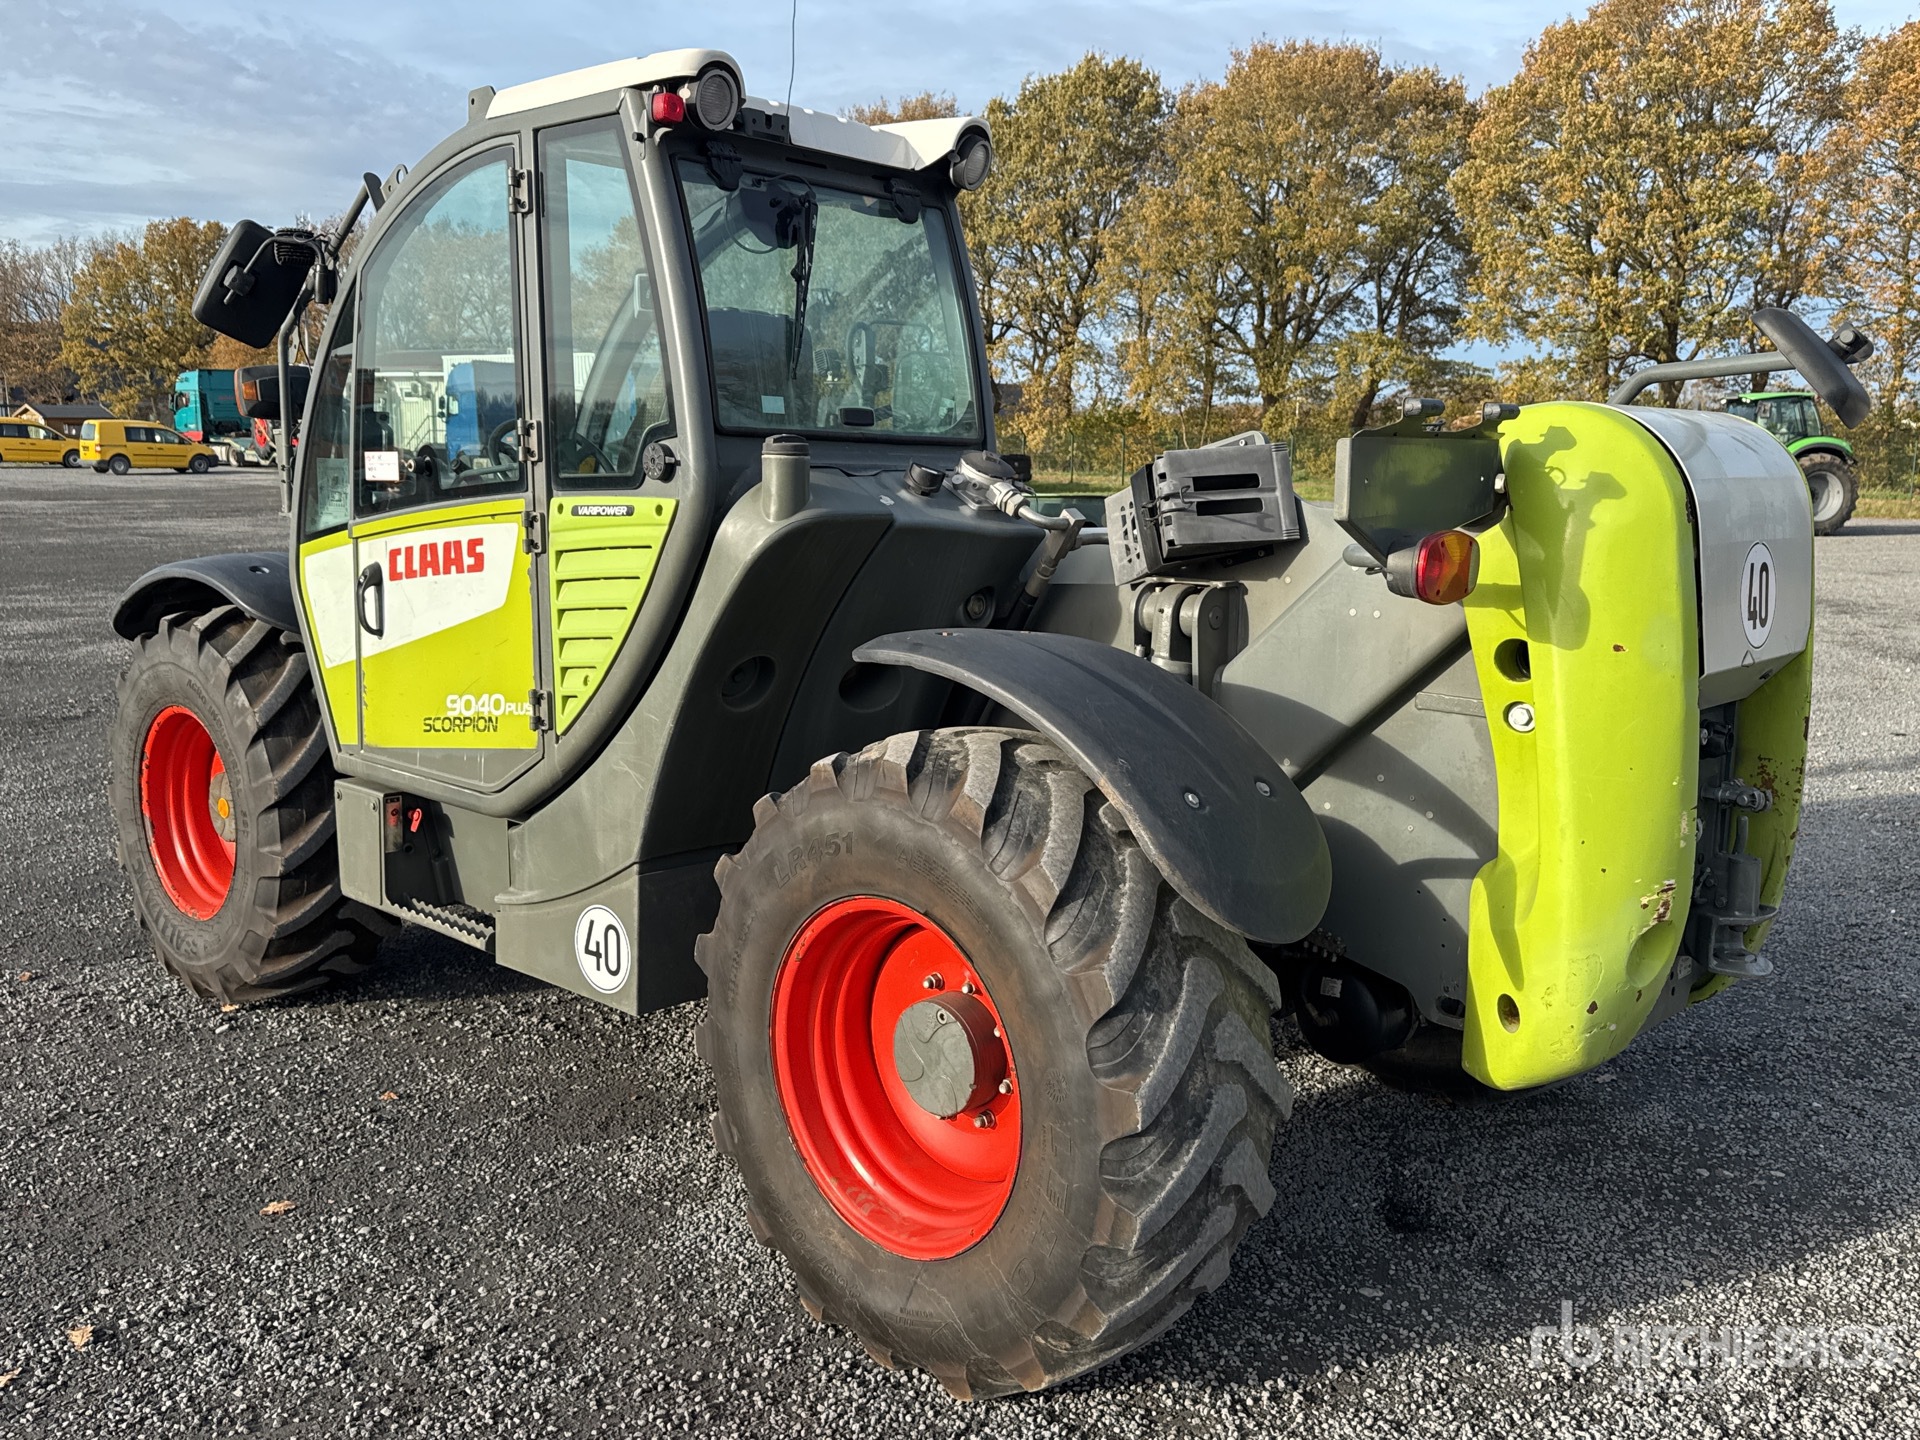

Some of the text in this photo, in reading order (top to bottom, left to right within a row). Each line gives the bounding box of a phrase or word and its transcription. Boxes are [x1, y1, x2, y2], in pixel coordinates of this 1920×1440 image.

[577, 505, 628, 516] VARIPOWER
[389, 537, 485, 582] CLAAS
[1747, 562, 1769, 630] 40
[423, 716, 499, 733] SCORPION
[773, 831, 854, 889] LR451
[584, 919, 621, 977] 40
